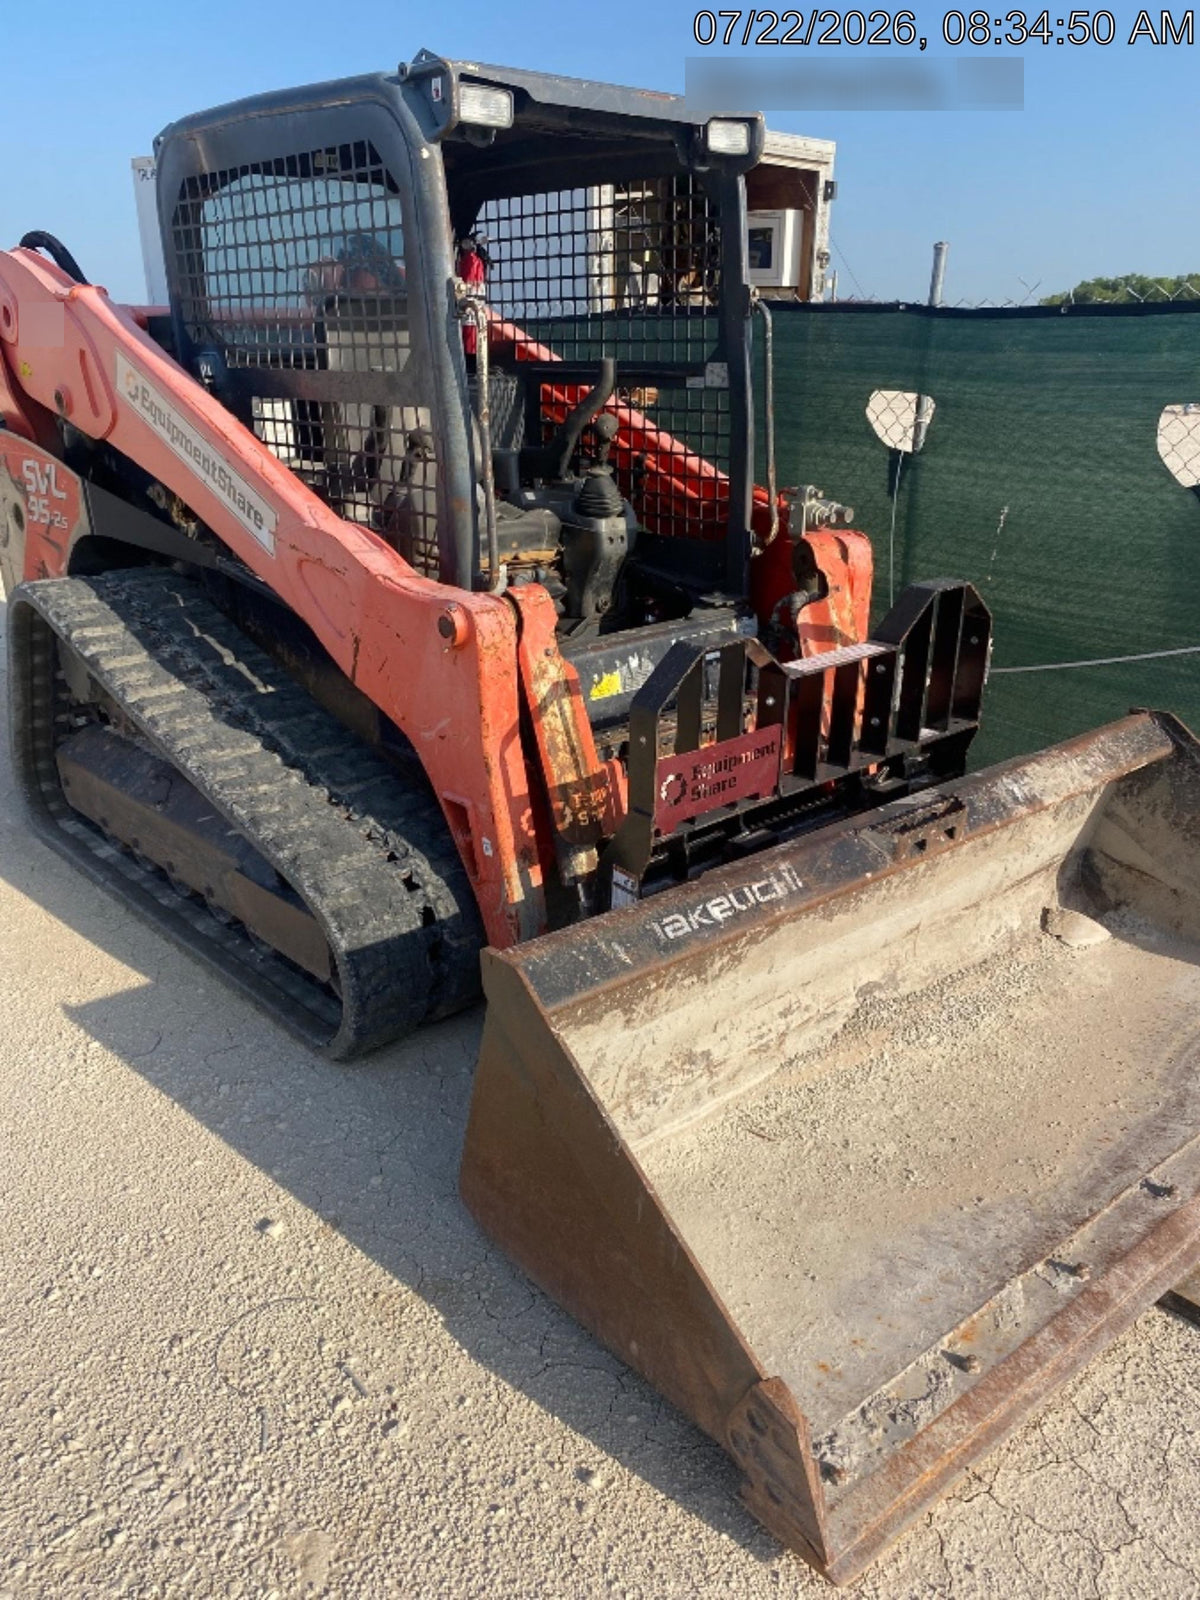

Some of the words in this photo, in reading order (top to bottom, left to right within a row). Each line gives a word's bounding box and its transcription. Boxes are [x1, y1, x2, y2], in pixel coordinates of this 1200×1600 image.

[141, 385, 264, 531] EquipmentShare
[22, 459, 67, 499] SVL
[691, 741, 776, 781] Equipment
[690, 776, 737, 802] Share
